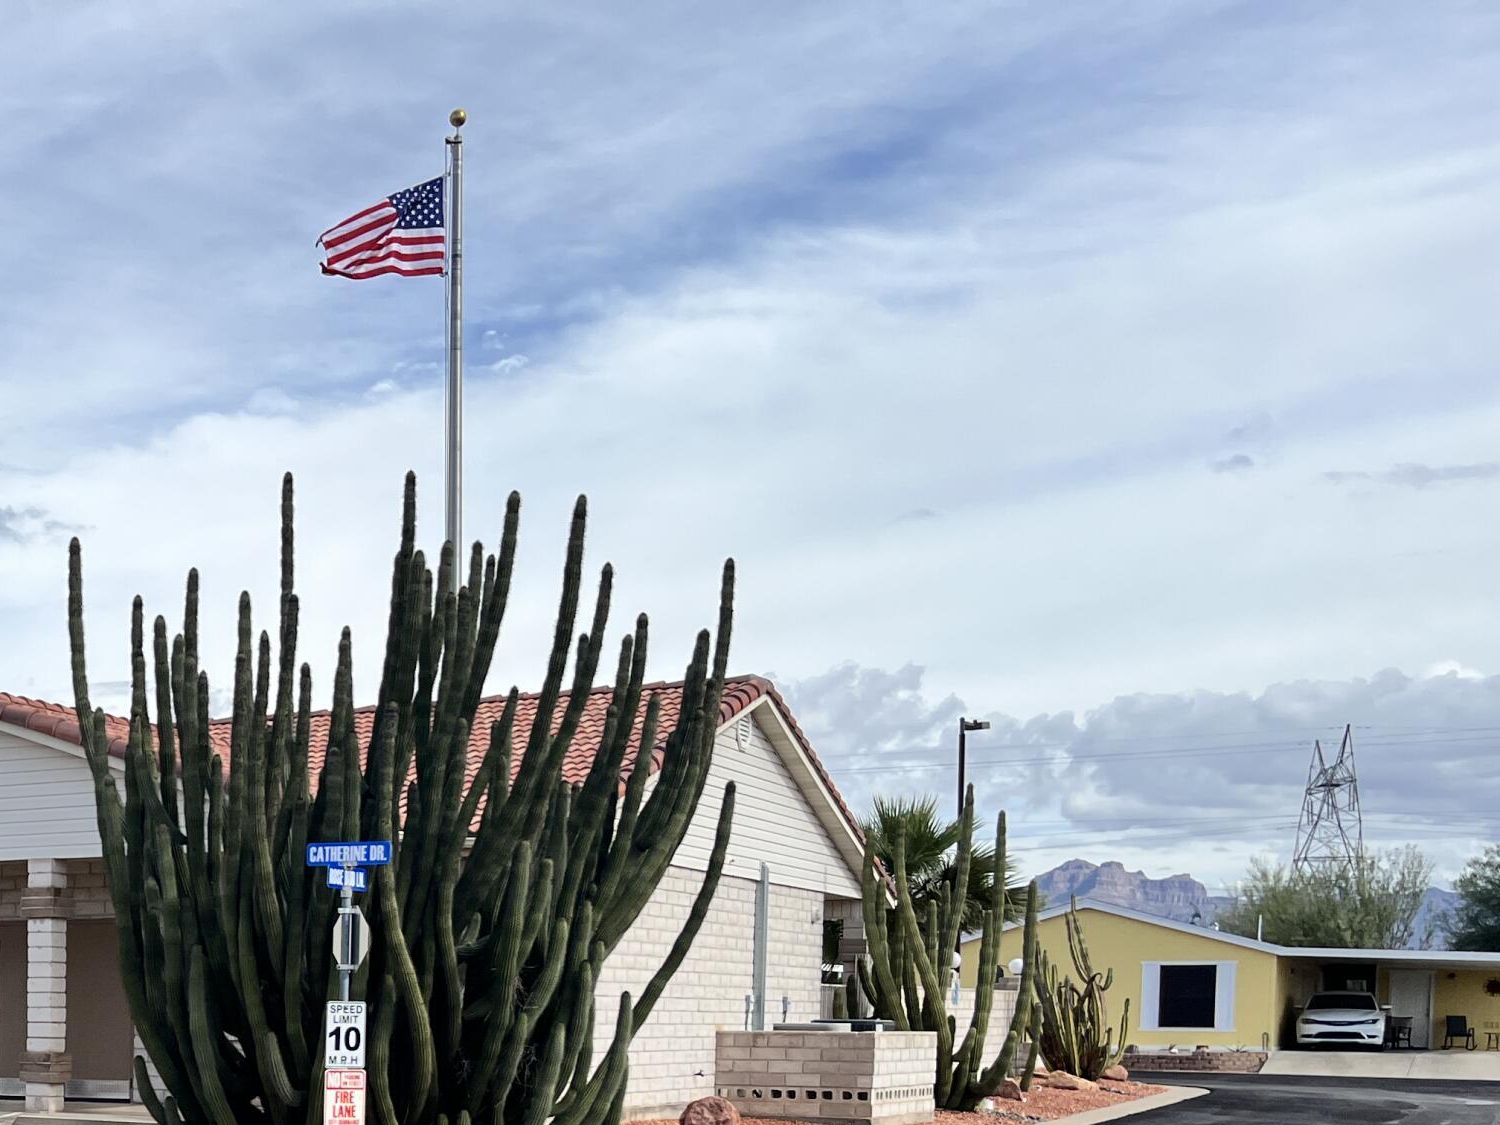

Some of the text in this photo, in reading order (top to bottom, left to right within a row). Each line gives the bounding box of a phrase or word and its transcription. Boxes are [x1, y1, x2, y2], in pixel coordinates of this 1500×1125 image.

[310, 845, 387, 862] CATHERINE DR.
[330, 1005, 363, 1014] SPEED
[333, 1015, 359, 1024] LIMIT
[329, 1026, 361, 1051] 10
[335, 1091, 355, 1103] FIRE
[332, 1105, 356, 1118] LANE
